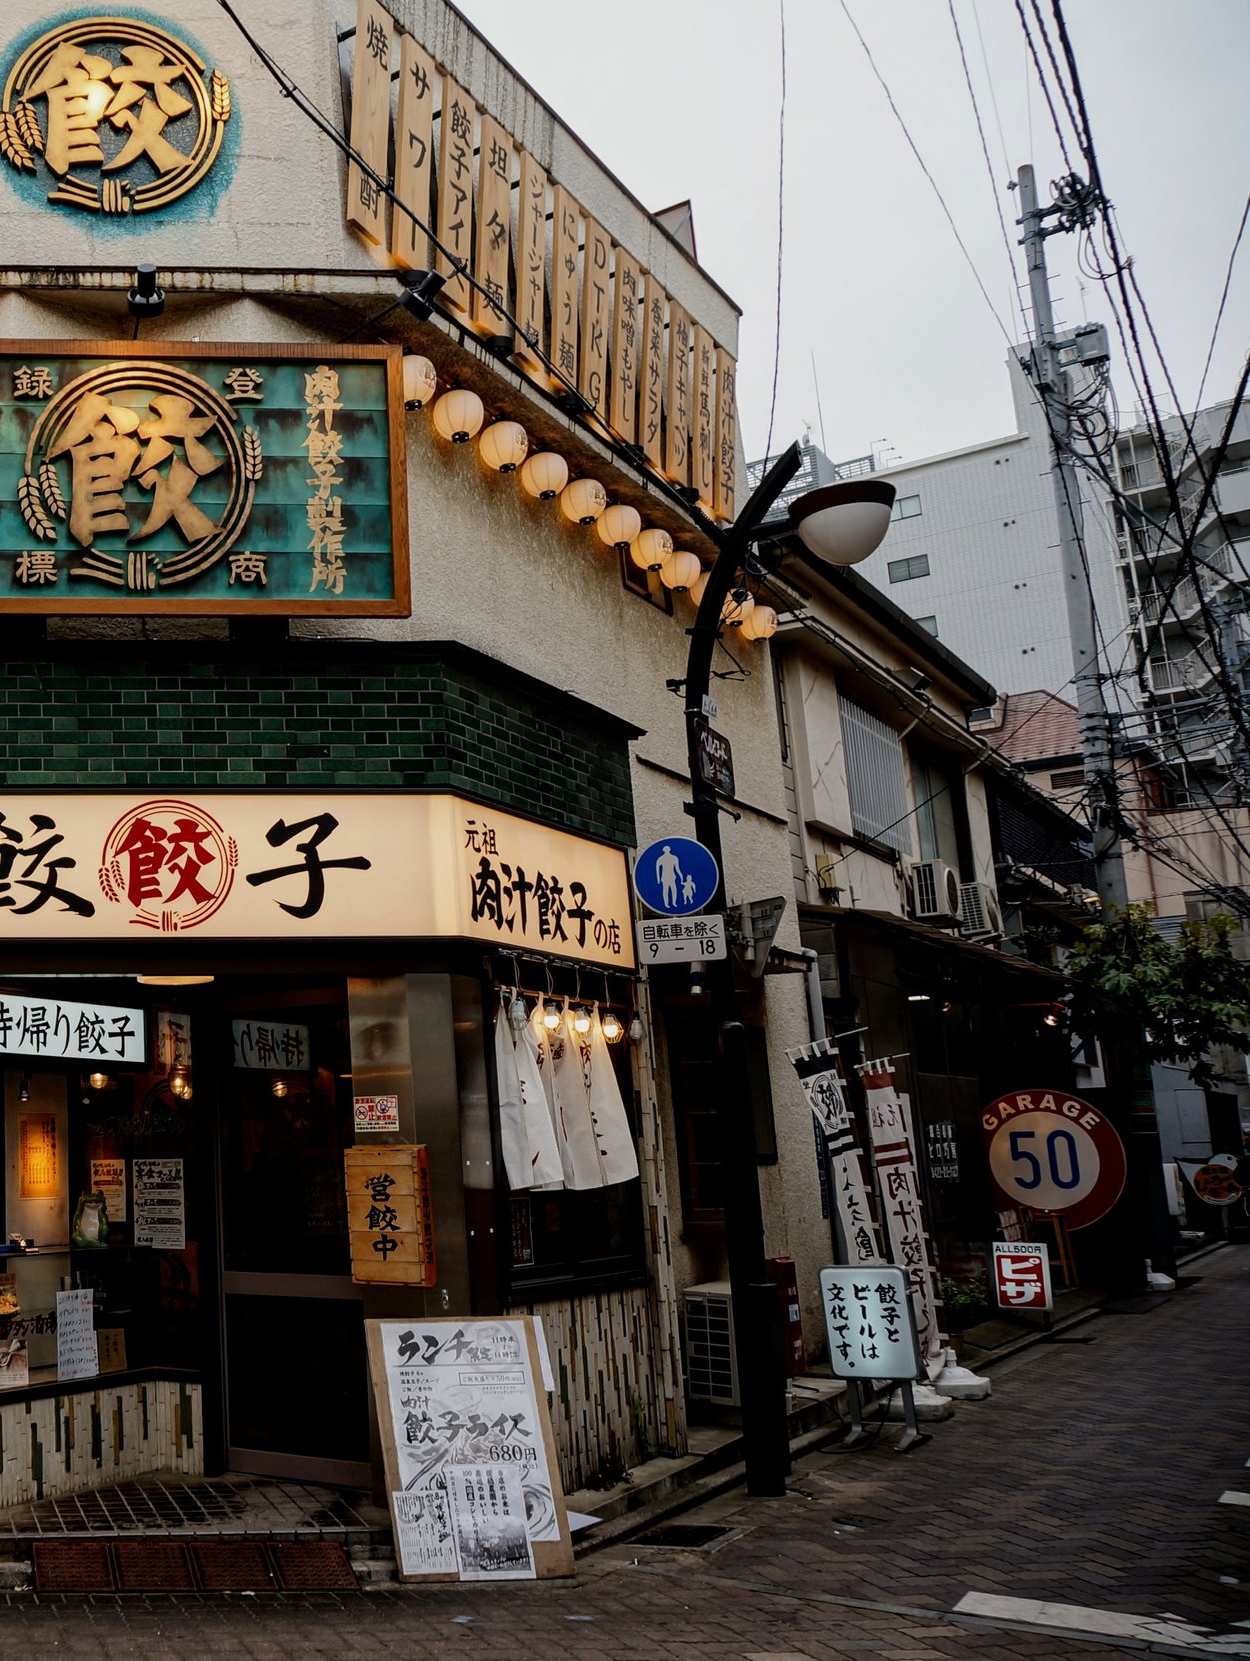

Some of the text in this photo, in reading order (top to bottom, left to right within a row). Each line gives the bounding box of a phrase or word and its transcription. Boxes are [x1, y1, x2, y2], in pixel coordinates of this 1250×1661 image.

[19, 41, 194, 176] 餃
[359, 13, 390, 221] 焼酎
[407, 60, 430, 252] サワー
[442, 100, 472, 292] 餃子アイス
[590, 237, 607, 405] DTKG
[620, 266, 637, 423] 肉味噌もやし
[223, 367, 264, 401] 登
[647, 297, 663, 444] 香菜サラダ
[674, 319, 689, 467] 柚子キャベツ
[47, 391, 224, 547] 餃
[720, 365, 735, 506] 肉汁餃子
[301, 364, 347, 595] 肉汁餃子製作所
[15, 550, 59, 584] 標
[228, 551, 268, 585] 商
[464, 819, 499, 856] 元祖
[642, 921, 720, 941] 自転車を除く
[982, 1094, 1101, 1131] GARAGE
[1009, 1130, 1080, 1190] 50
[364, 1173, 401, 1261] 営餃中
[995, 1245, 1042, 1255] ALL500円
[874, 1283, 901, 1343] 餃子と
[1000, 1258, 1042, 1305] ピザ
[827, 1283, 855, 1369] 文化です。
[852, 1283, 880, 1359] ビールは
[401, 1395, 432, 1410] 肉汁
[403, 1411, 533, 1444] 餃子ライス
[490, 1444, 537, 1462] 680円
